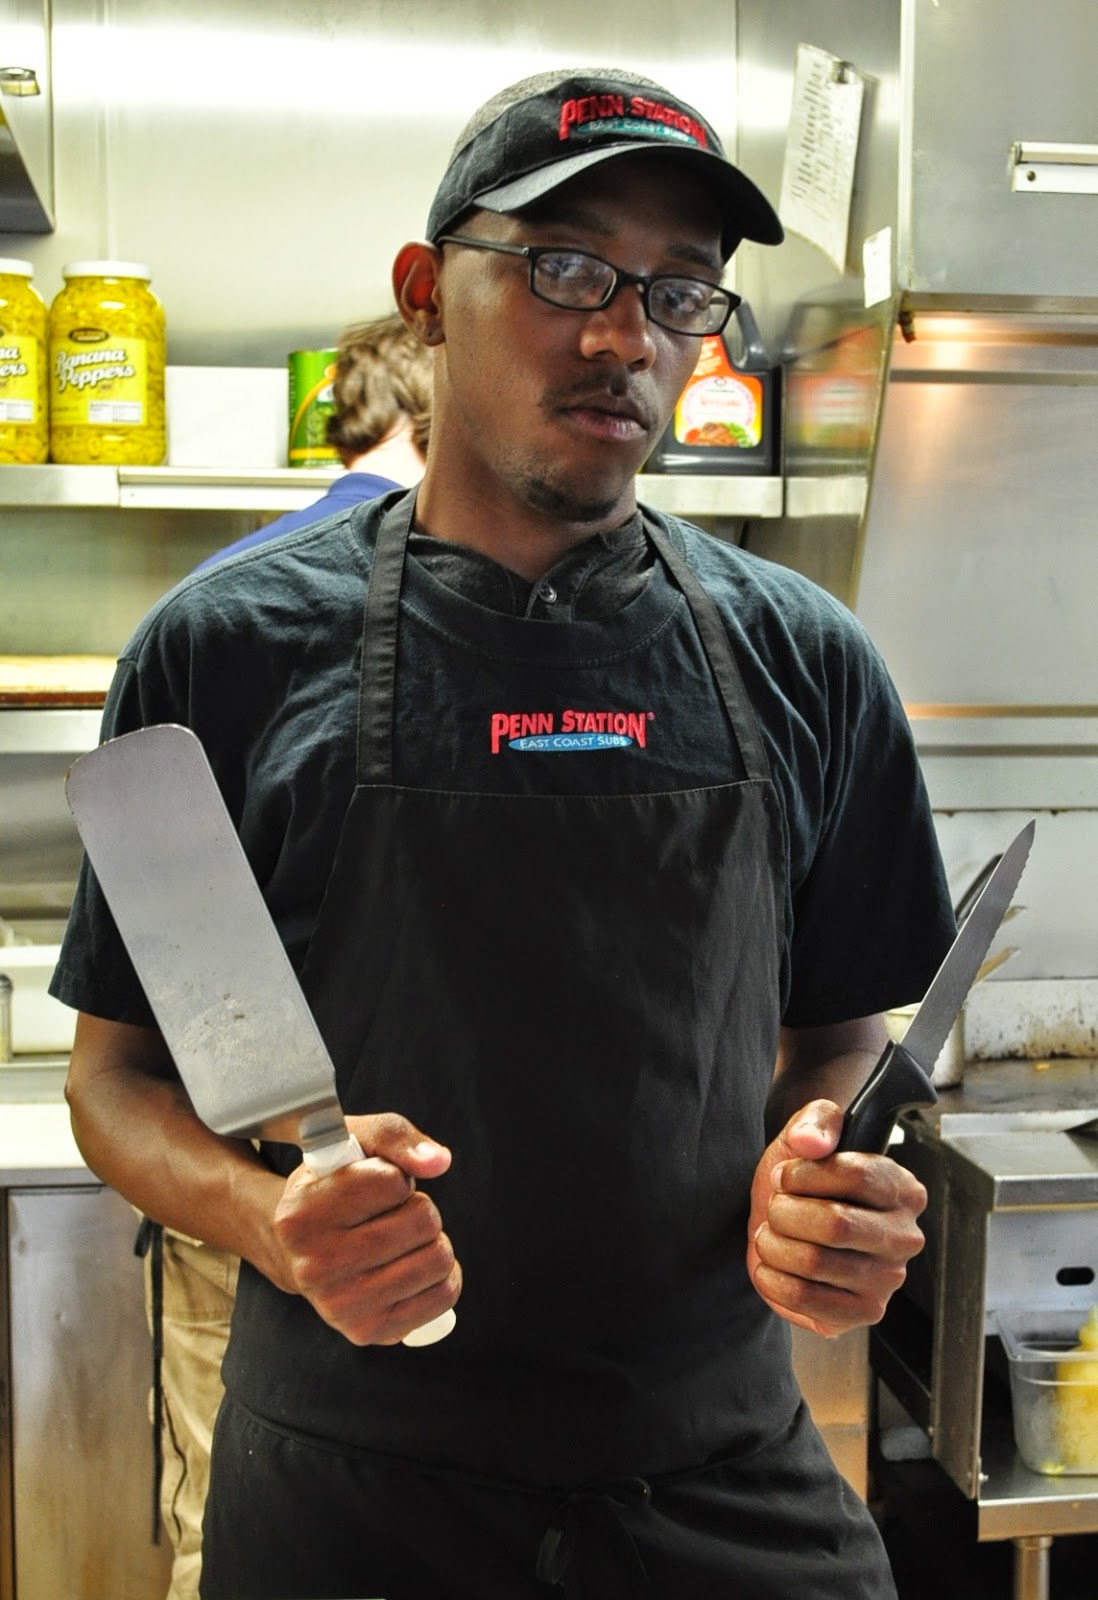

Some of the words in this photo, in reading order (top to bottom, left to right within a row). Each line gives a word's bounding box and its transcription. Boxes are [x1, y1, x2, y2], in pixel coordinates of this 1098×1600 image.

[559, 94, 624, 141] PENN
[630, 95, 708, 150] STATION
[56, 349, 126, 377] Banana
[59, 364, 135, 392] Peppers
[491, 712, 553, 754] PENN
[519, 739, 549, 749] EAST
[553, 737, 594, 747] COAST
[597, 735, 627, 746] SUBS
